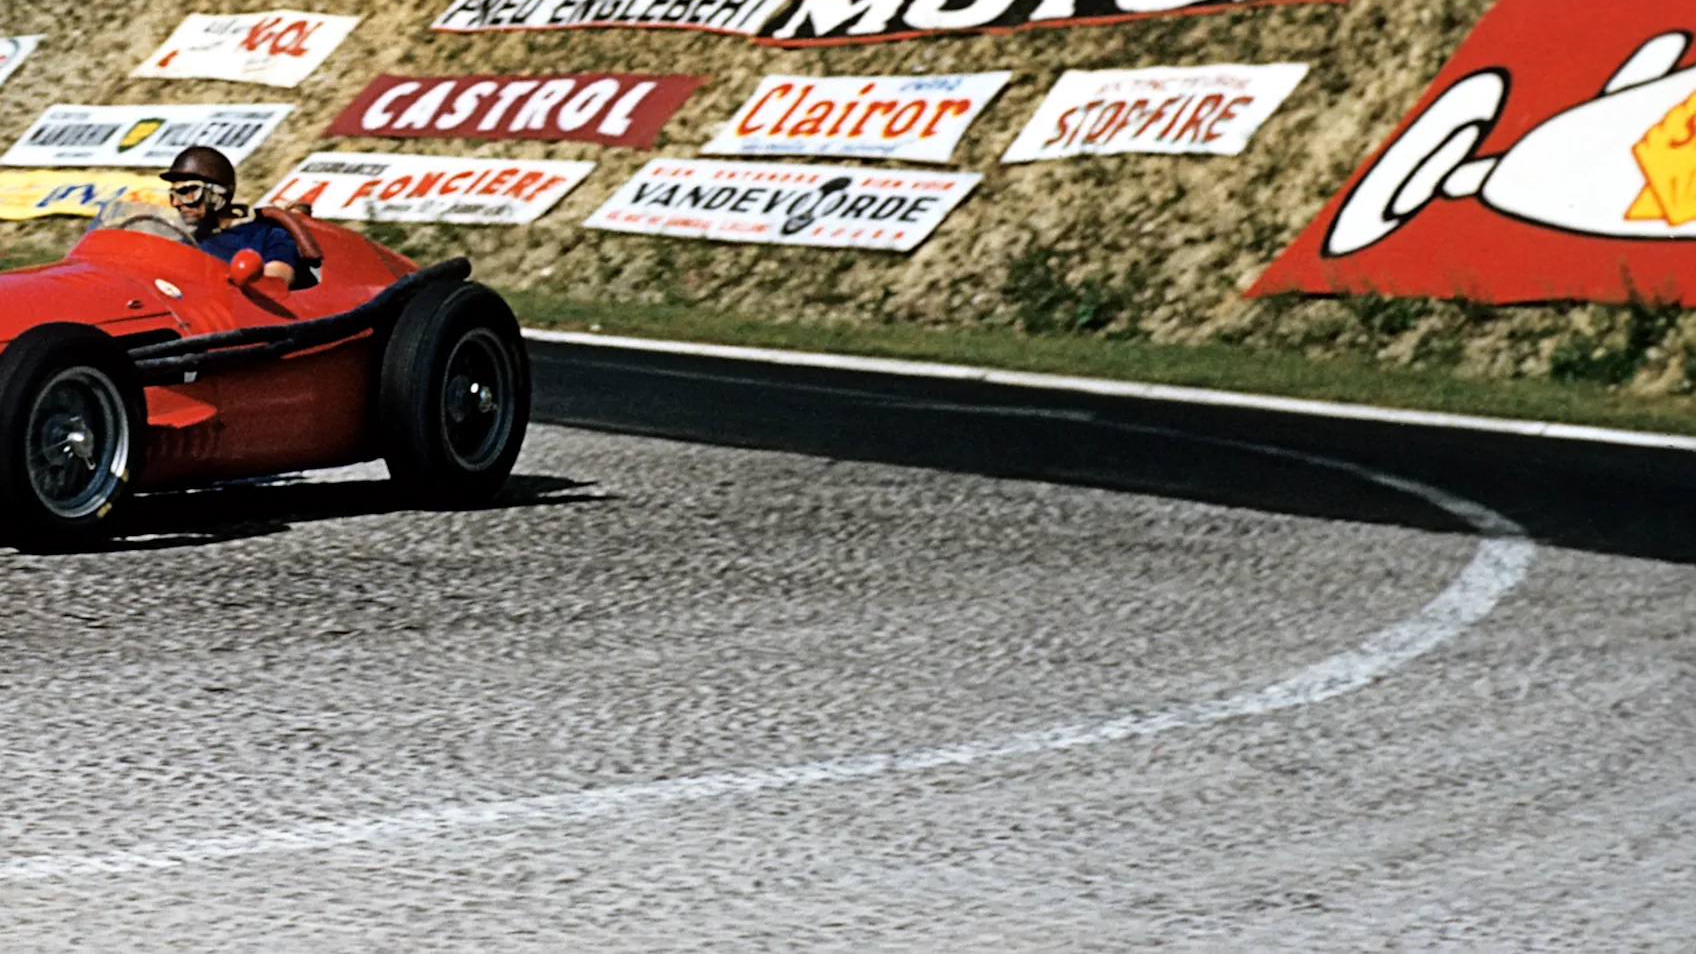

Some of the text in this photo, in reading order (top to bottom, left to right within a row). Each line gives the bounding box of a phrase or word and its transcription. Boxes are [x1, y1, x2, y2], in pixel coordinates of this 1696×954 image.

[360, 78, 658, 137] CASTROL
[735, 82, 973, 139] Clairor
[269, 177, 329, 204] LA
